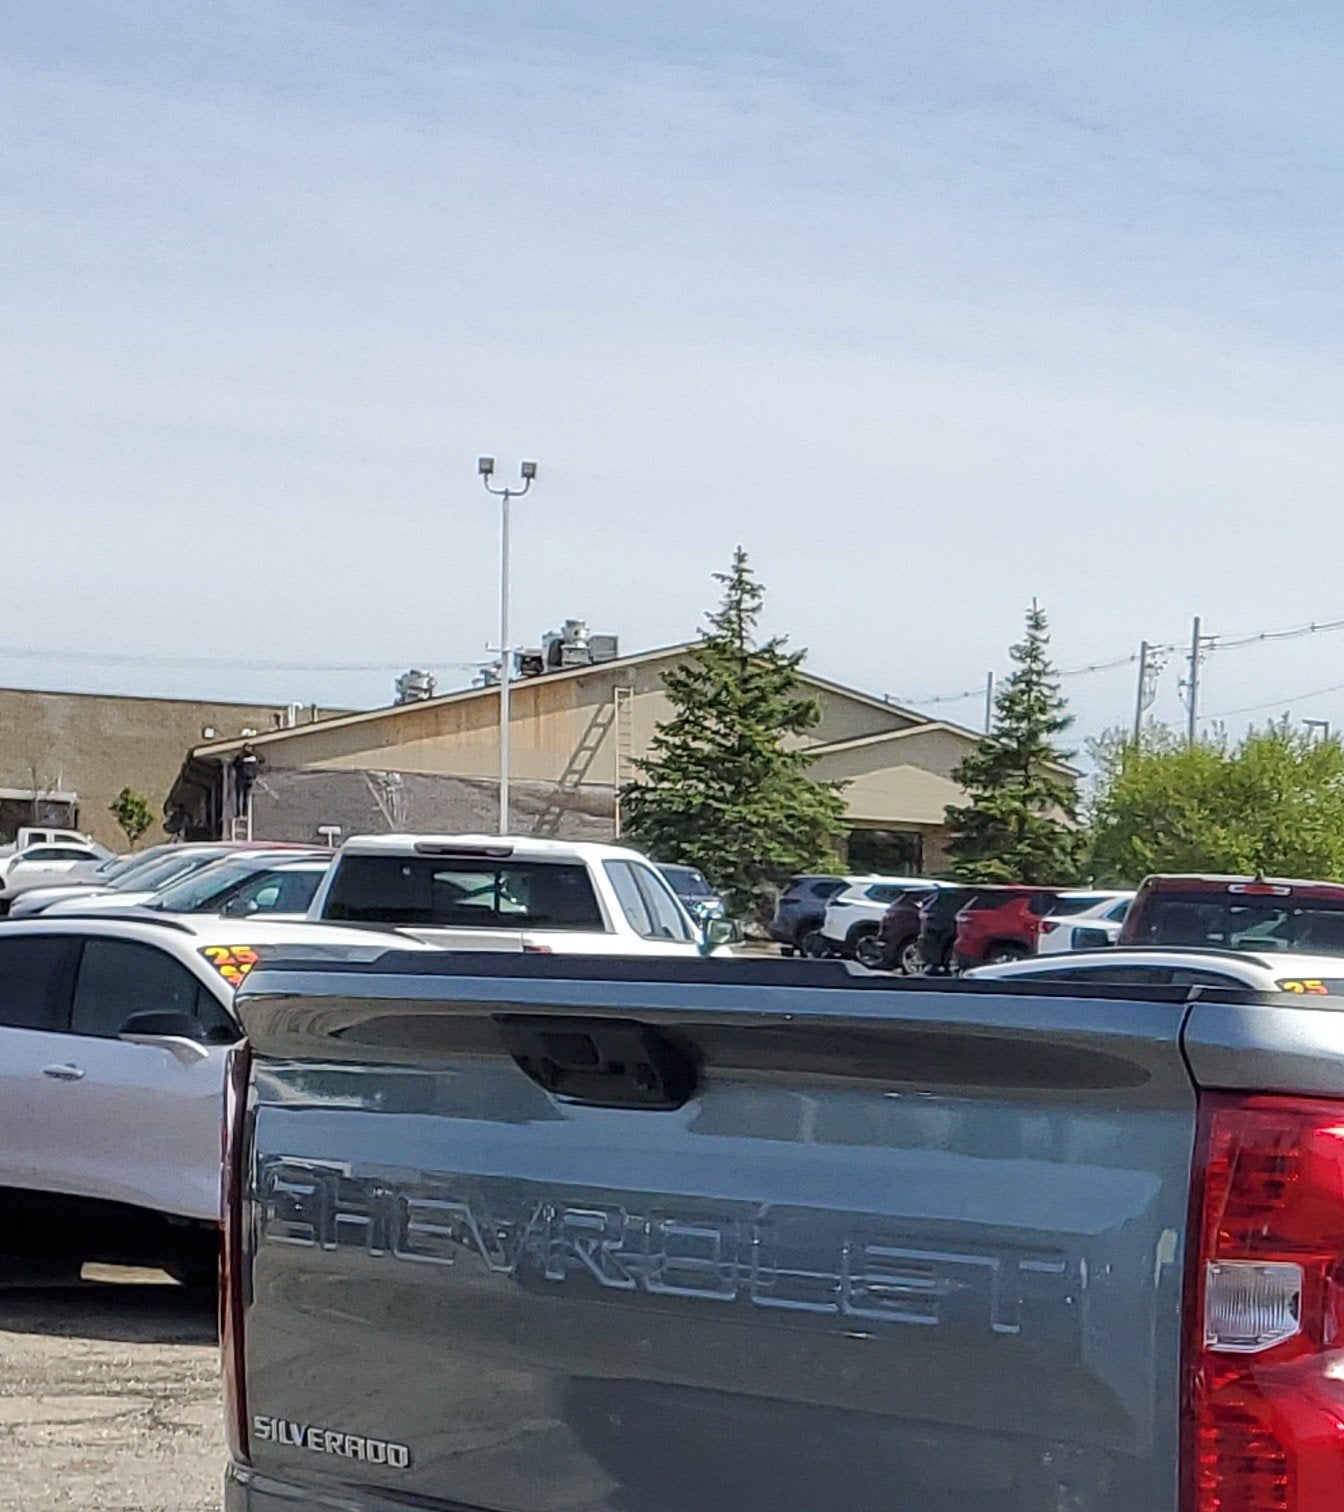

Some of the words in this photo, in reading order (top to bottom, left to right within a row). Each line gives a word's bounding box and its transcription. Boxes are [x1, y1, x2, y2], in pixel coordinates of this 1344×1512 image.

[205, 946, 258, 965] 25
[262, 1163, 1066, 1334] CHEVROLET
[252, 1414, 411, 1469] SILVERADO
